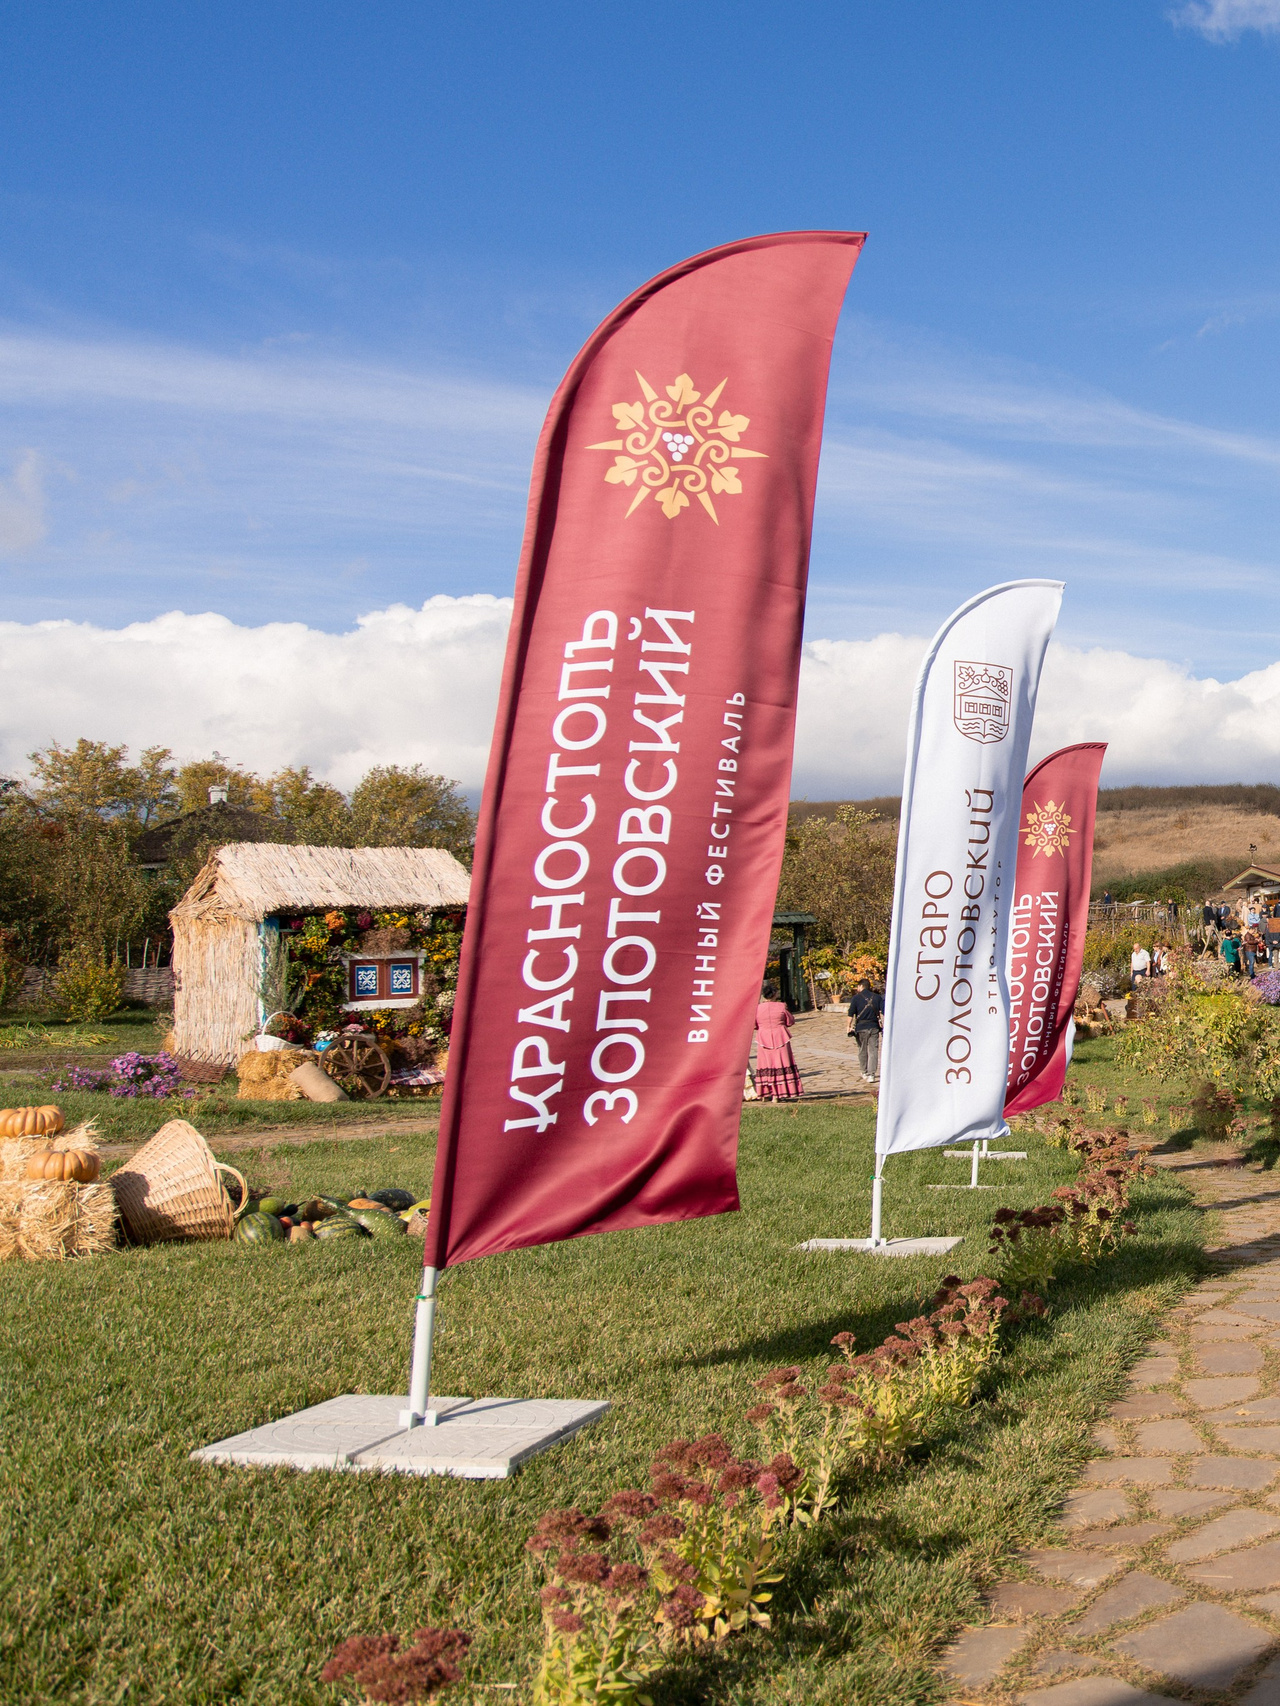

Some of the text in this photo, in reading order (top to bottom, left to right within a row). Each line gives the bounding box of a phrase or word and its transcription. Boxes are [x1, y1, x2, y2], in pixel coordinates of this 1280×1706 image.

[583, 606, 695, 1127] ЗОЛОТОВСКИЙ
[687, 692, 746, 1043] ВИННЫЙ ФЕСТИВАЛЬ
[1016, 891, 1059, 1085] ЗОЛОТОВСКИЙ
[1042, 922, 1069, 1056] ВИННЫЙ ФЕСТИВАЛЬ
